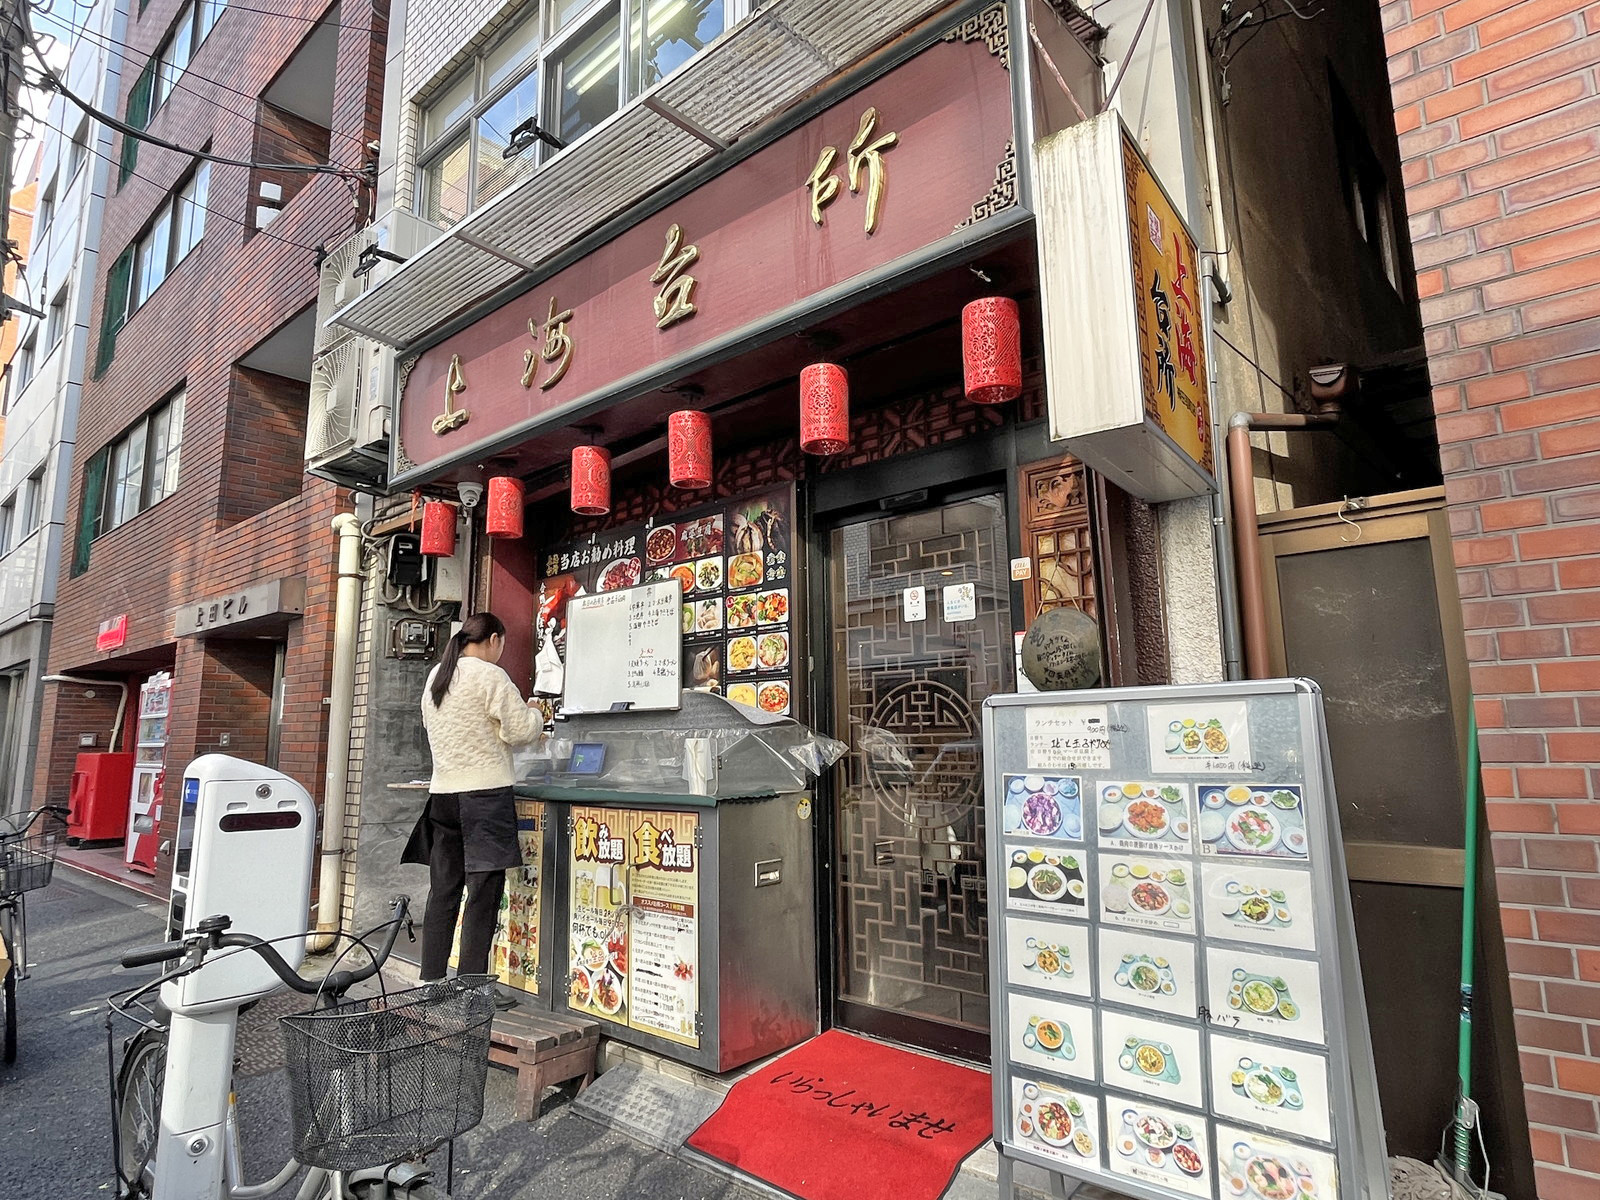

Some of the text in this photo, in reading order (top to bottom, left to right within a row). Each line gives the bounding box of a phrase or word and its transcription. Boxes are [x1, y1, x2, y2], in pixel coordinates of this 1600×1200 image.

[560, 535, 637, 571] 当店お勧め料理
[195, 595, 249, 628] 上田ビル
[575, 817, 624, 862] 飲み放題
[634, 821, 692, 868] 食べ放題
[769, 1071, 957, 1140] いらっしゃいませ
